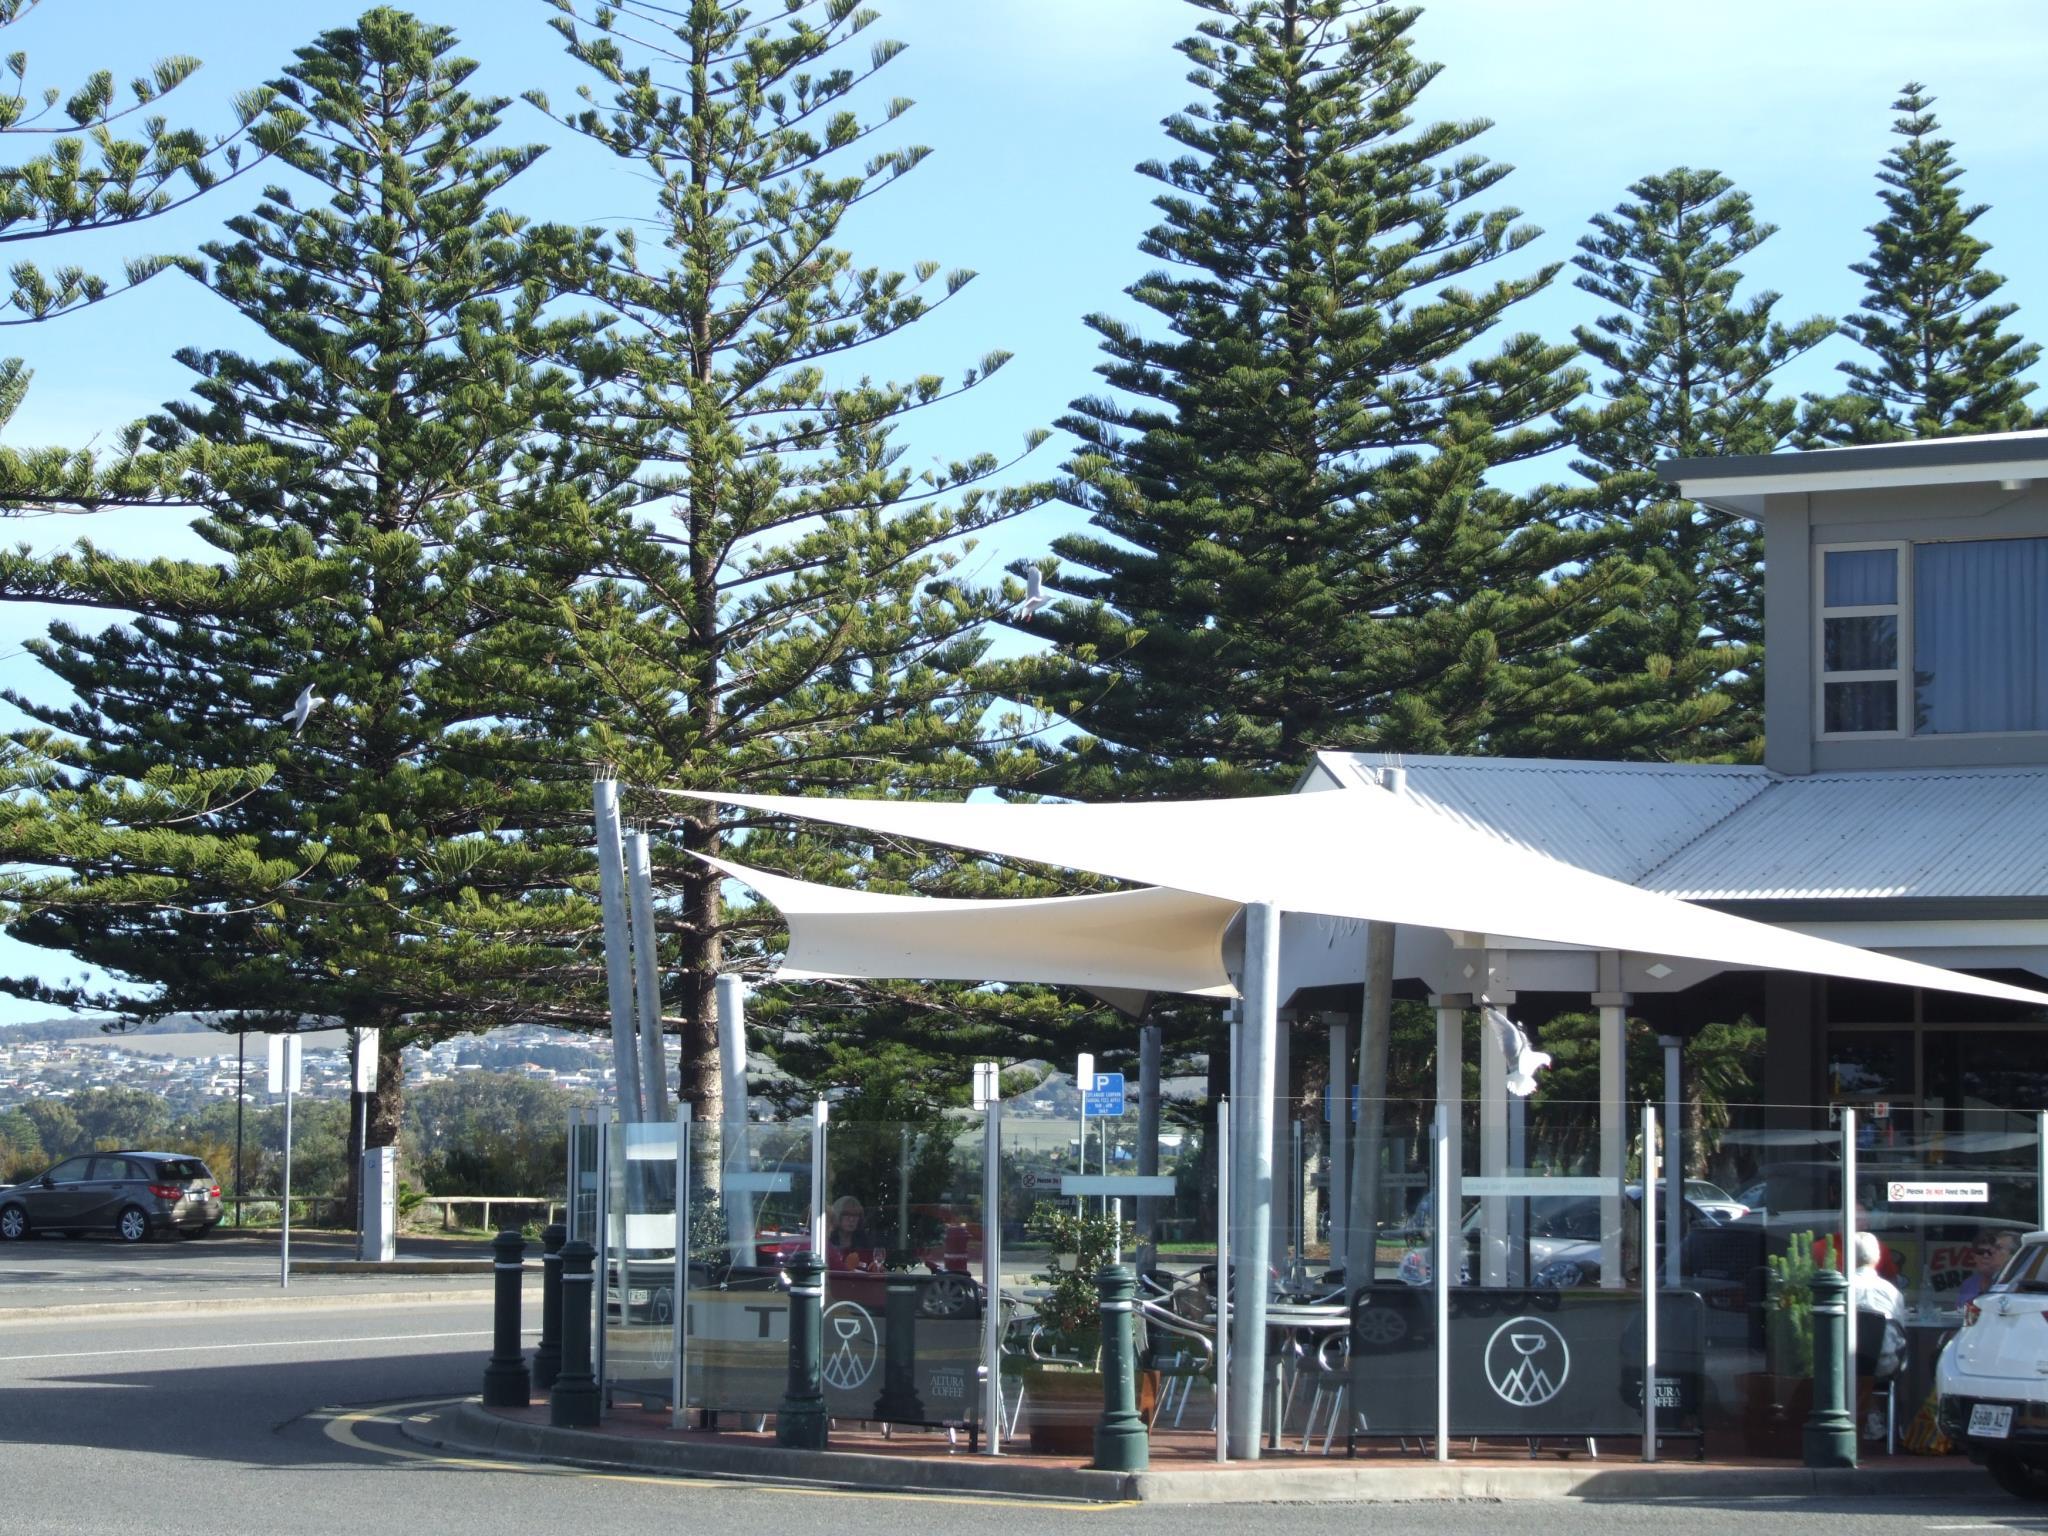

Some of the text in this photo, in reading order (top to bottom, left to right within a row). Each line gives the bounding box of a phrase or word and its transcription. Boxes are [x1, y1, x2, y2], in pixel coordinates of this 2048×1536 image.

[1096, 1076, 1110, 1091] P
[929, 1375, 965, 1387] ALTURA
[931, 1387, 965, 1397] COFFEE
